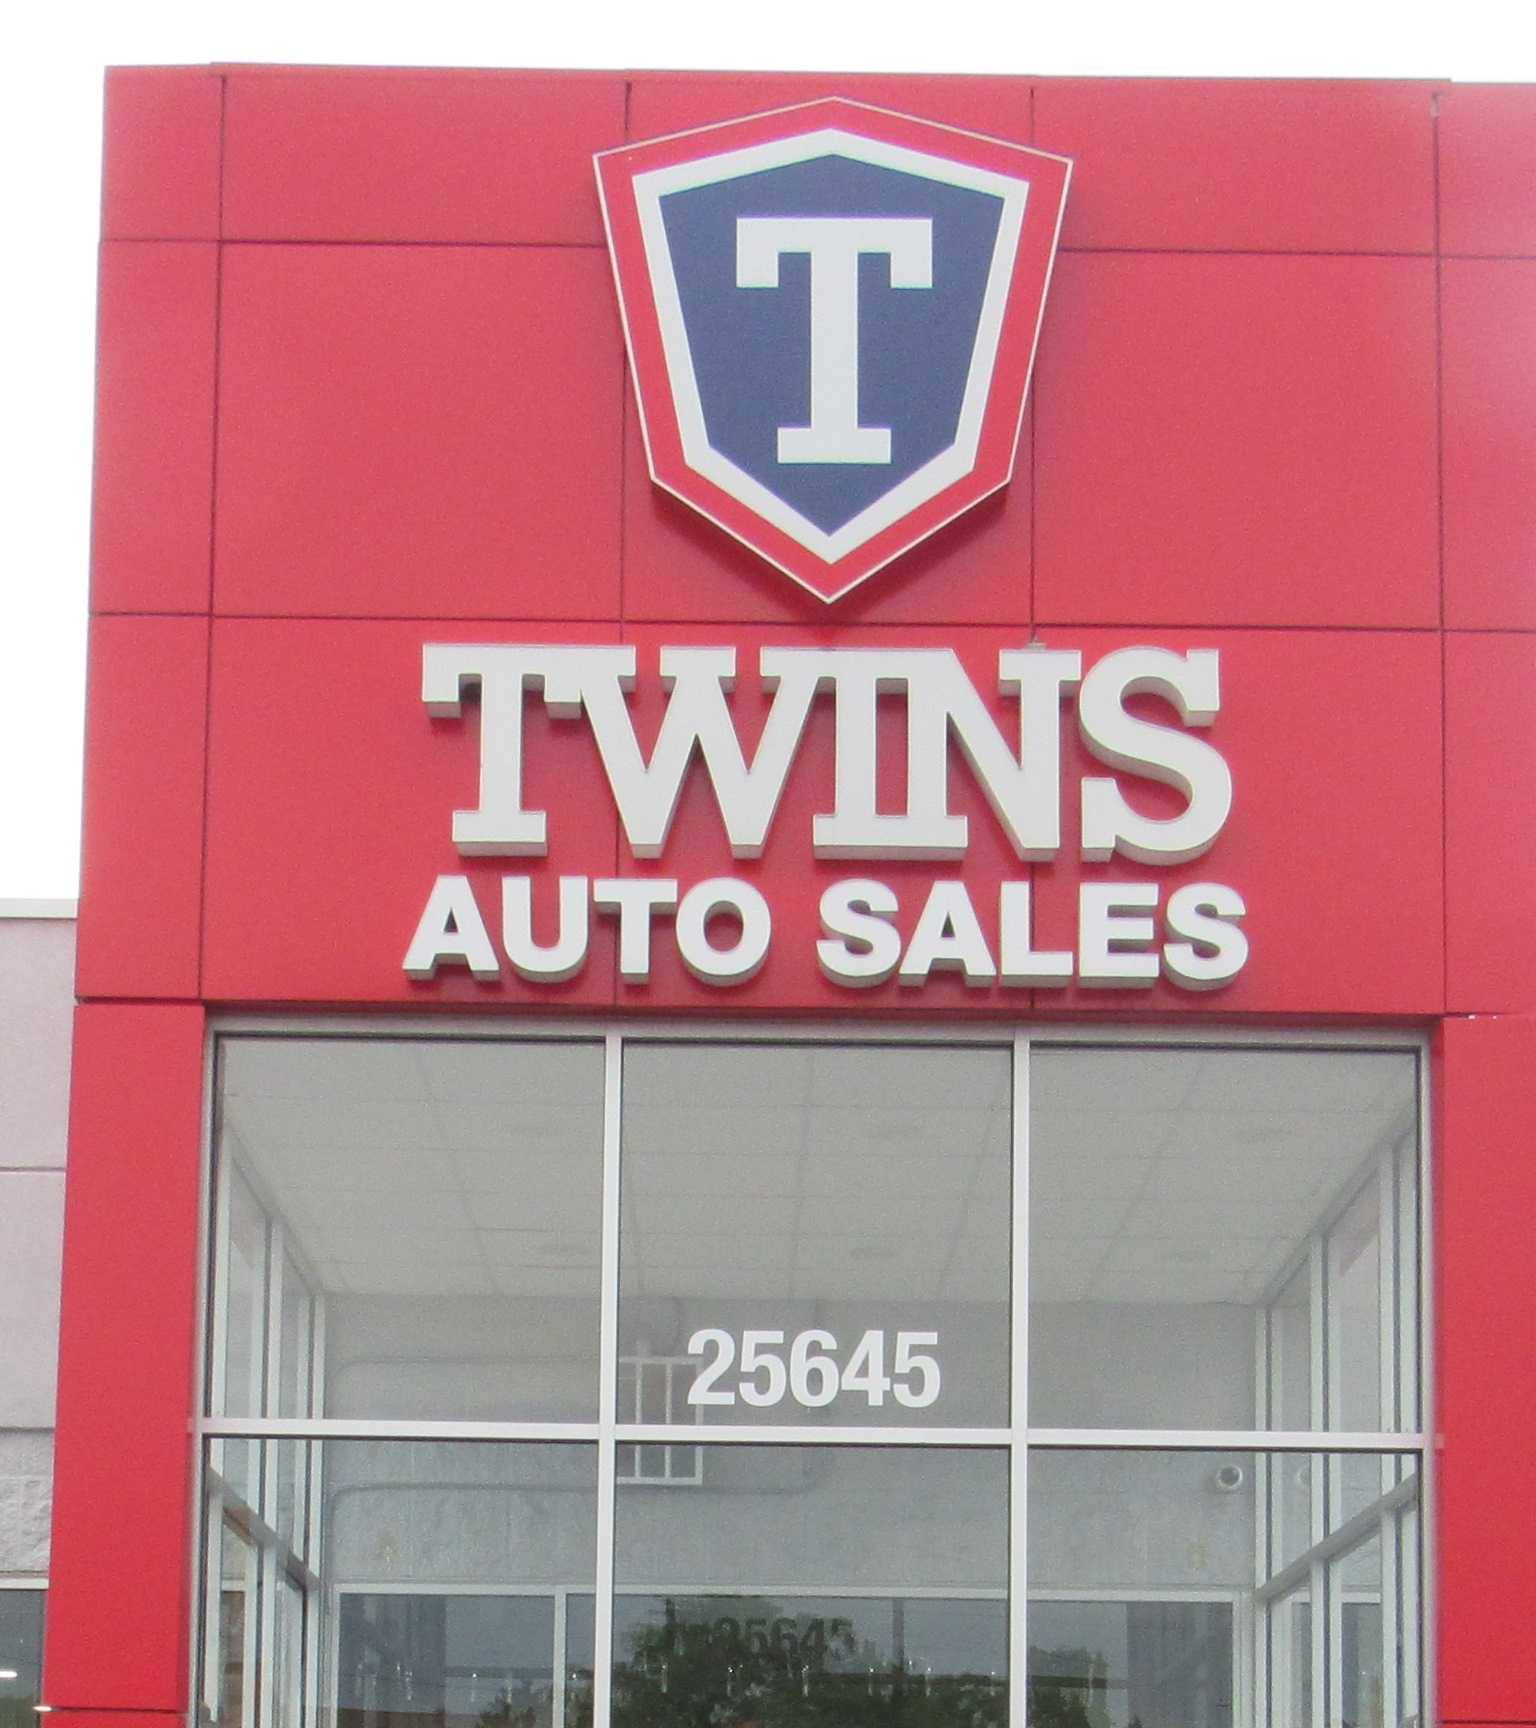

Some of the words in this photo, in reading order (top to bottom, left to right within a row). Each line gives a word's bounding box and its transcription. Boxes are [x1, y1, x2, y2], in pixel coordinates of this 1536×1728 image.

[736, 217, 933, 464] T
[422, 642, 1233, 863] TWINS
[402, 873, 772, 986] AUTO
[816, 878, 1249, 989] SALES
[687, 1328, 941, 1408] 25645
